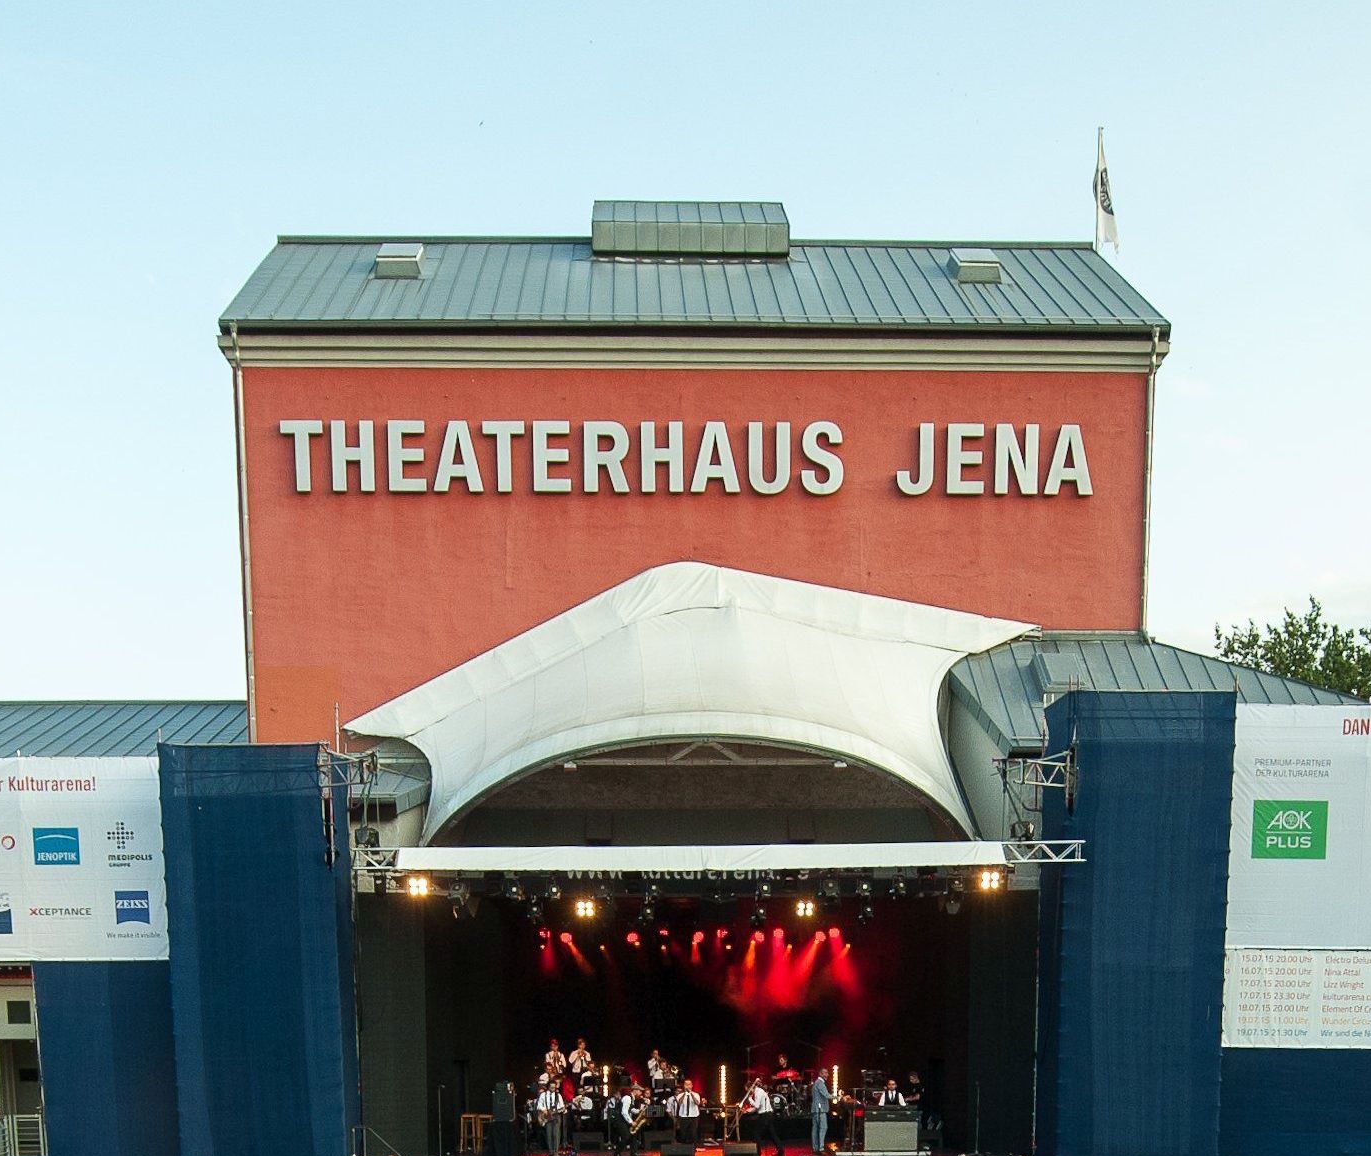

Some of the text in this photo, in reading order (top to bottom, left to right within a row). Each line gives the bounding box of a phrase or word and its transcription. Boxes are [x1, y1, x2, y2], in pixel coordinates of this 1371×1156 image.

[279, 418, 1094, 497] THEATERHAUS JENA
[1254, 757, 1332, 767] PREMIUM-PARTNER
[1255, 768, 1330, 778] DER KULTURARENA
[8, 776, 96, 792] Kulturarena!
[1267, 810, 1313, 830] AOK
[1266, 836, 1312, 848] PLUS
[36, 851, 78, 862] JENOPTIK
[115, 899, 149, 909] ZEISS
[29, 907, 92, 917] XCEPTANCE
[117, 931, 133, 939] make
[1242, 954, 1274, 963] 15.07.15
[1299, 954, 1313, 963] Uhr
[1322, 993, 1365, 1001] kulturarena
[1321, 1005, 1353, 1013] Element
[1320, 1029, 1333, 1037] Wir
[1334, 1029, 1350, 1037] sind
[1351, 1029, 1363, 1037] die
